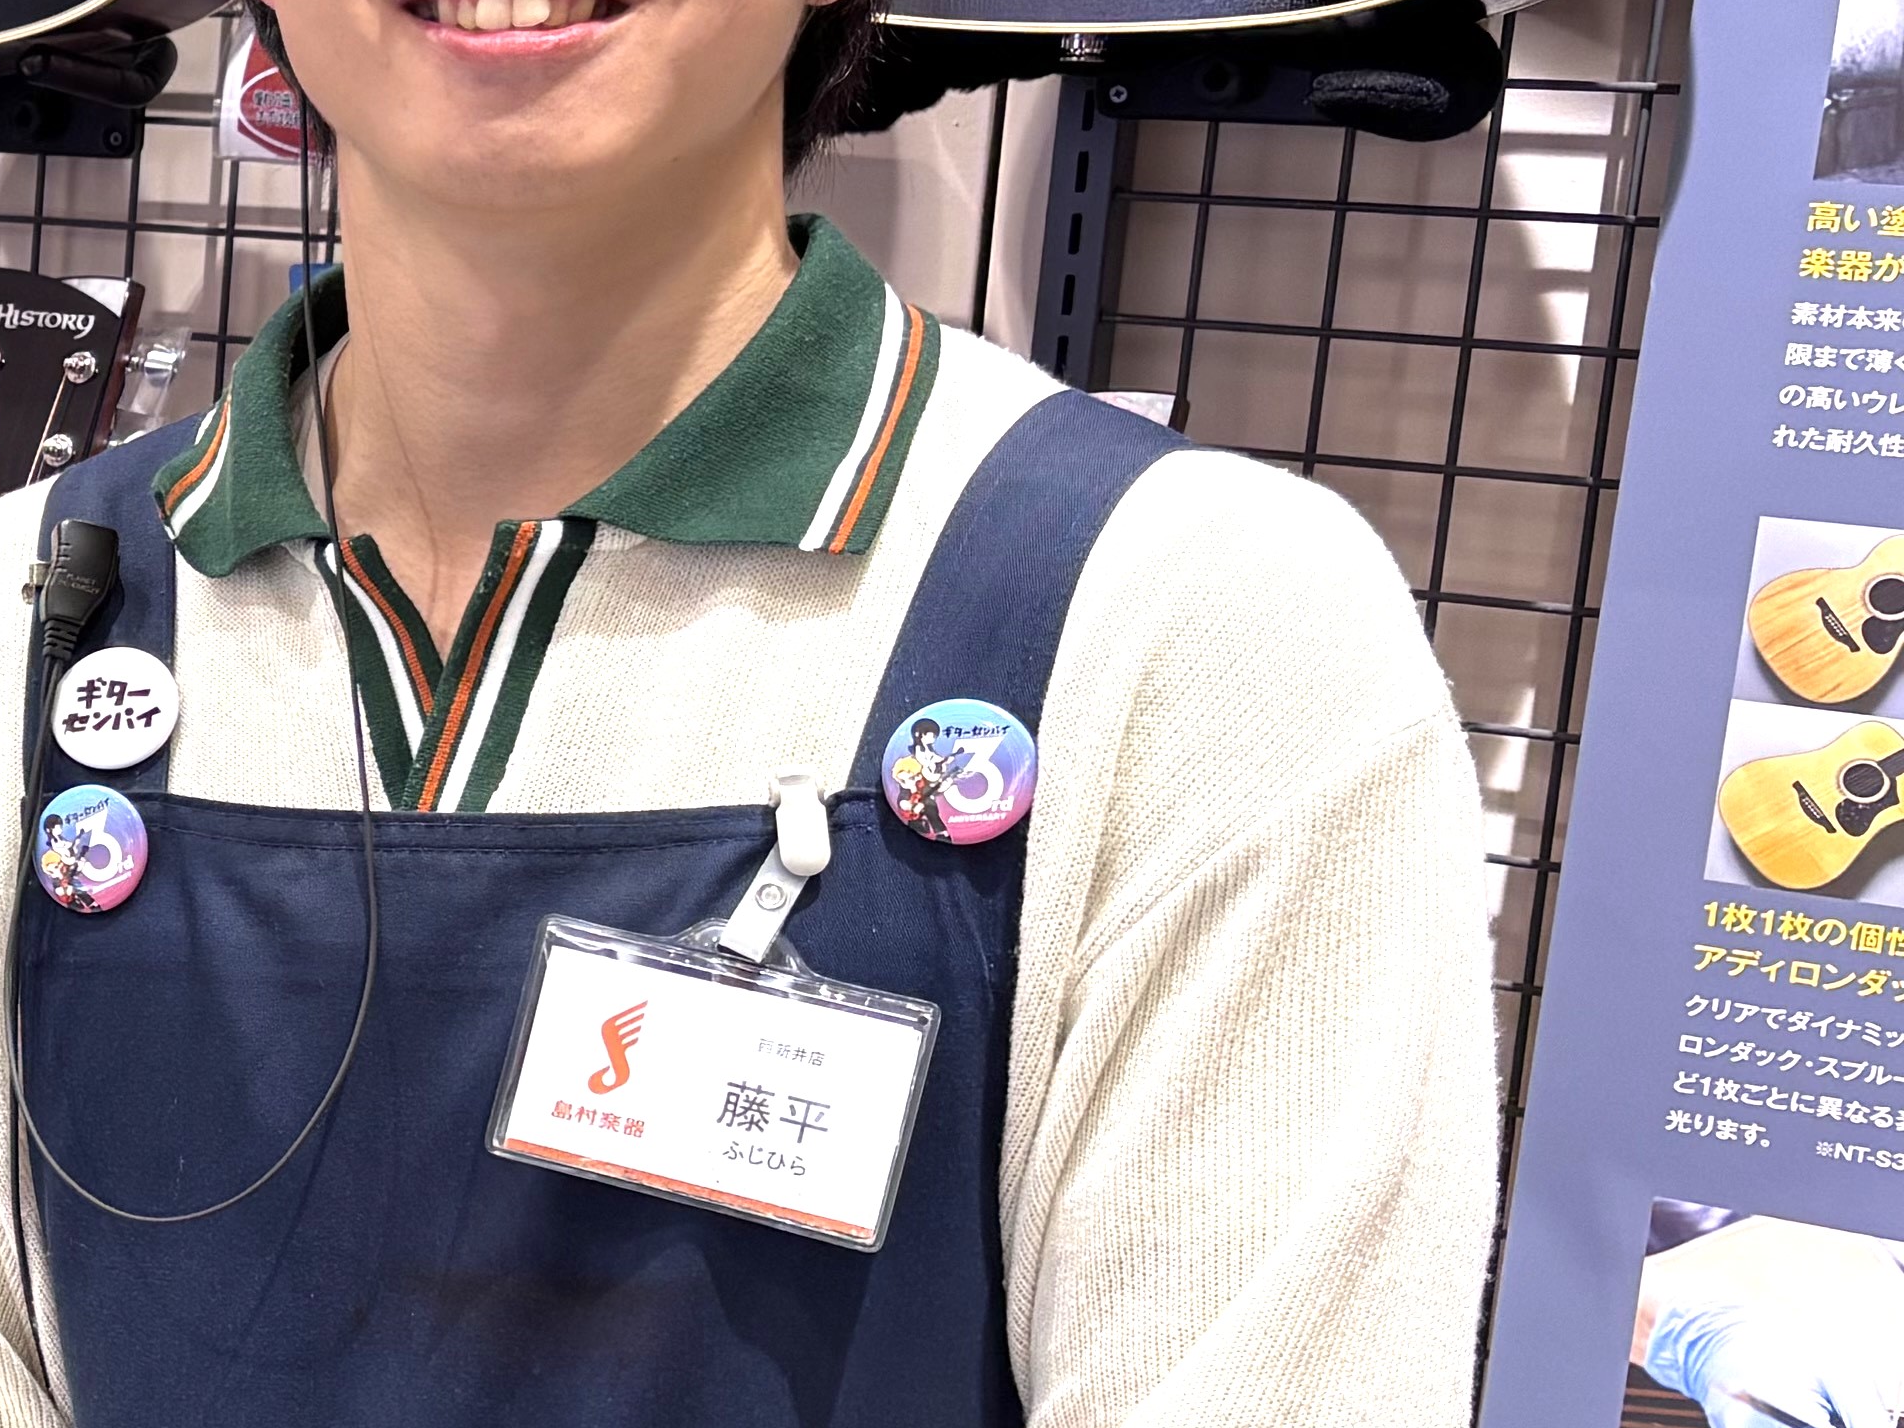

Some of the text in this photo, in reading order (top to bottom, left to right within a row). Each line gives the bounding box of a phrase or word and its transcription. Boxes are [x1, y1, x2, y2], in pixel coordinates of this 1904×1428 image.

[1790, 301, 1904, 332] 素材本来
[76, 676, 152, 710] ギター
[61, 705, 162, 735] センパイ
[757, 1037, 826, 1068] 西新井店
[550, 1099, 646, 1139] 島村楽器
[716, 1080, 832, 1145] 藤平
[1665, 1109, 1770, 1148] 光ります。
[722, 1141, 808, 1177] ふじひら
